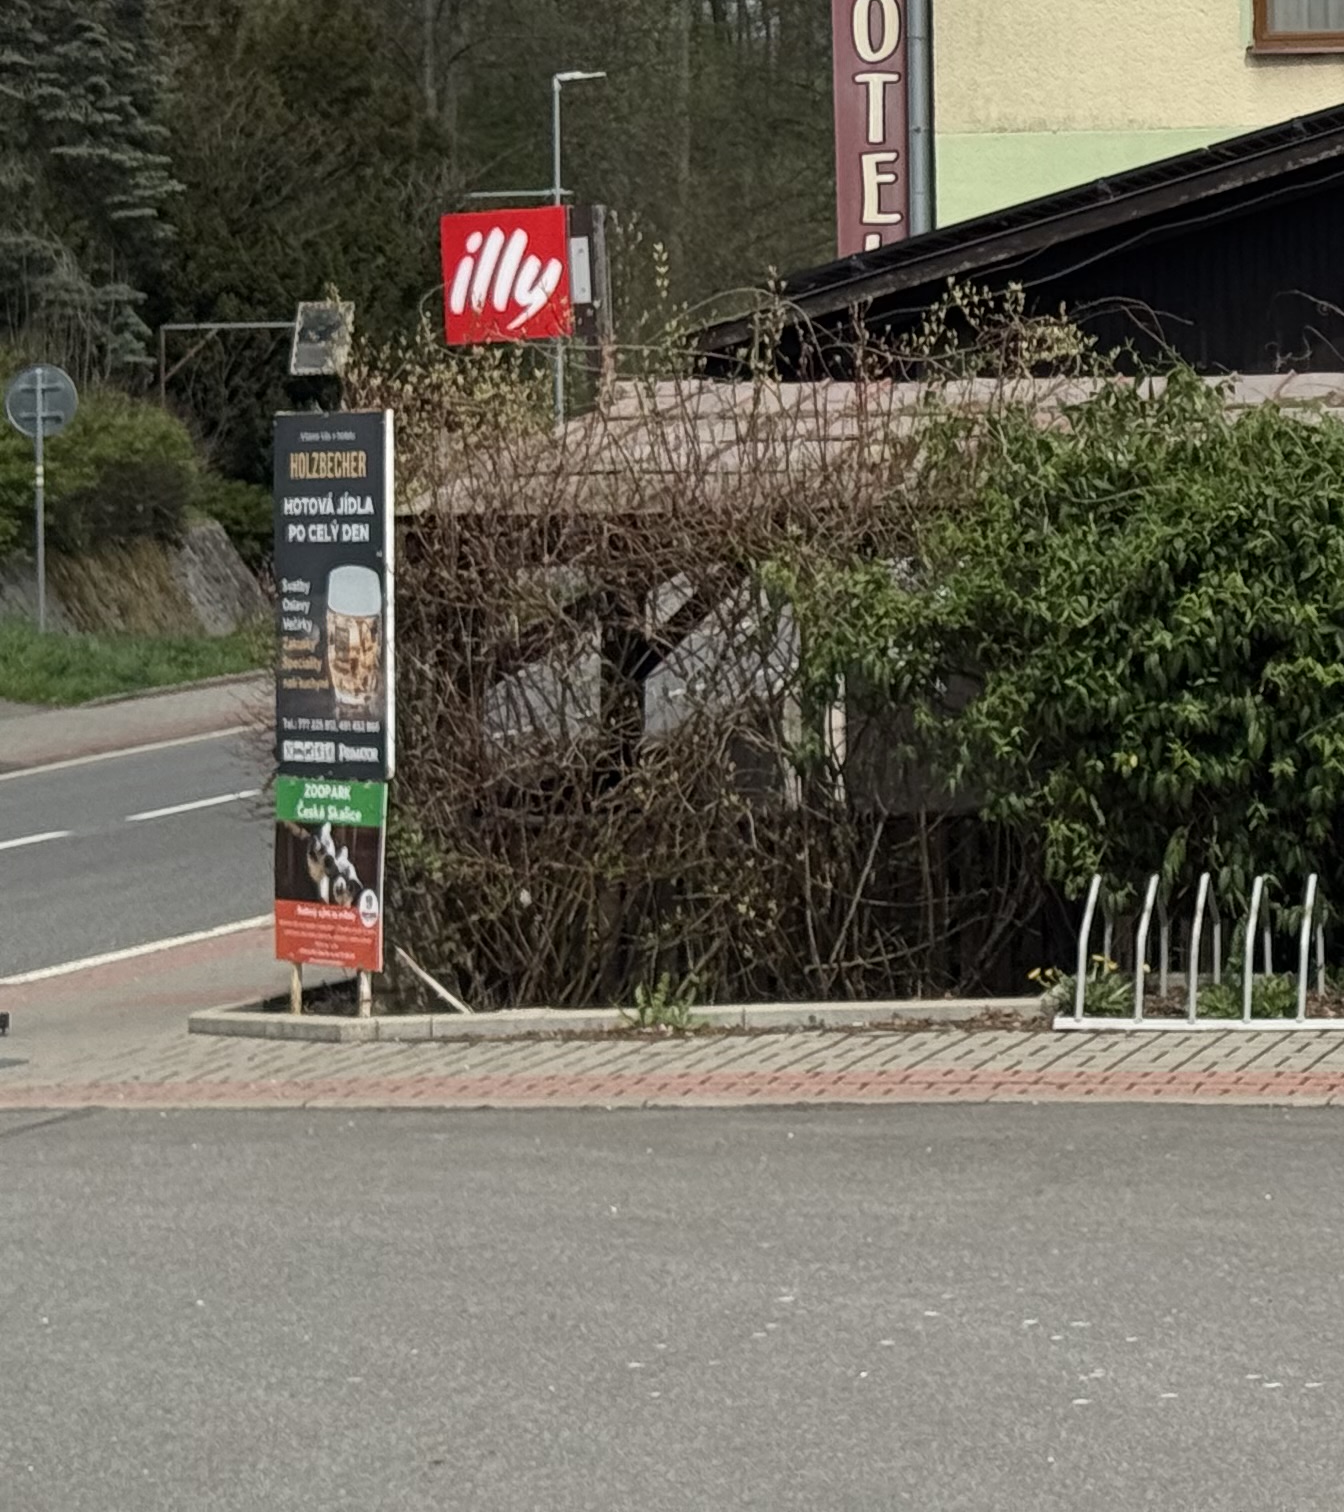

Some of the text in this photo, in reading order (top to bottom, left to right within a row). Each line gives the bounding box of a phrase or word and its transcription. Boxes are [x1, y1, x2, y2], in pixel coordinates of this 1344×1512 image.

[449, 226, 563, 330] illy
[290, 450, 367, 480] HOLZBECHER
[283, 491, 375, 516] HOTOVÁ JÍDLA
[287, 518, 370, 543] PO CELÝ DEN
[304, 783, 351, 801] ZOOPARK
